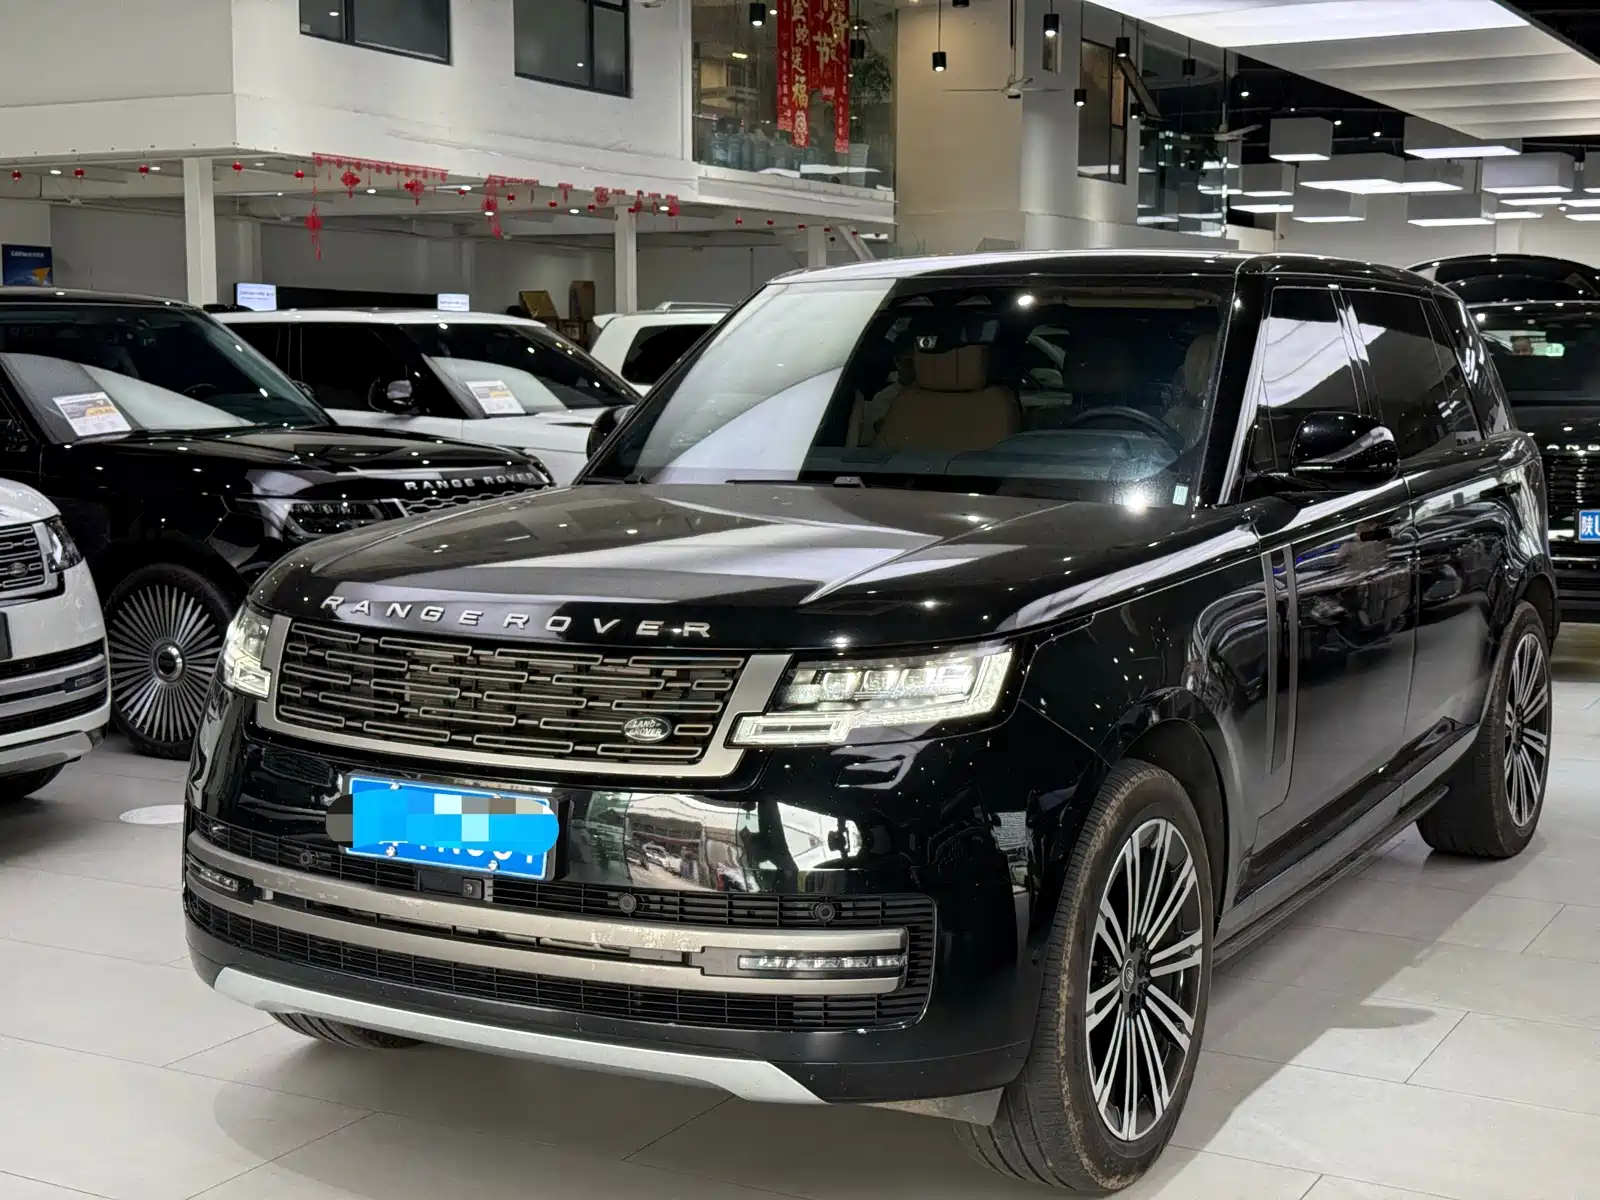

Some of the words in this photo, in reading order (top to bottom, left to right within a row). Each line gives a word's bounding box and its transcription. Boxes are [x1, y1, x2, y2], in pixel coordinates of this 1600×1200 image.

[404, 478, 476, 490] RANGE
[482, 472, 537, 485] ROVER
[320, 596, 483, 626] RANGE
[502, 613, 711, 638] ROVER
[632, 719, 656, 728] LAND
[632, 728, 662, 737] ROVER
